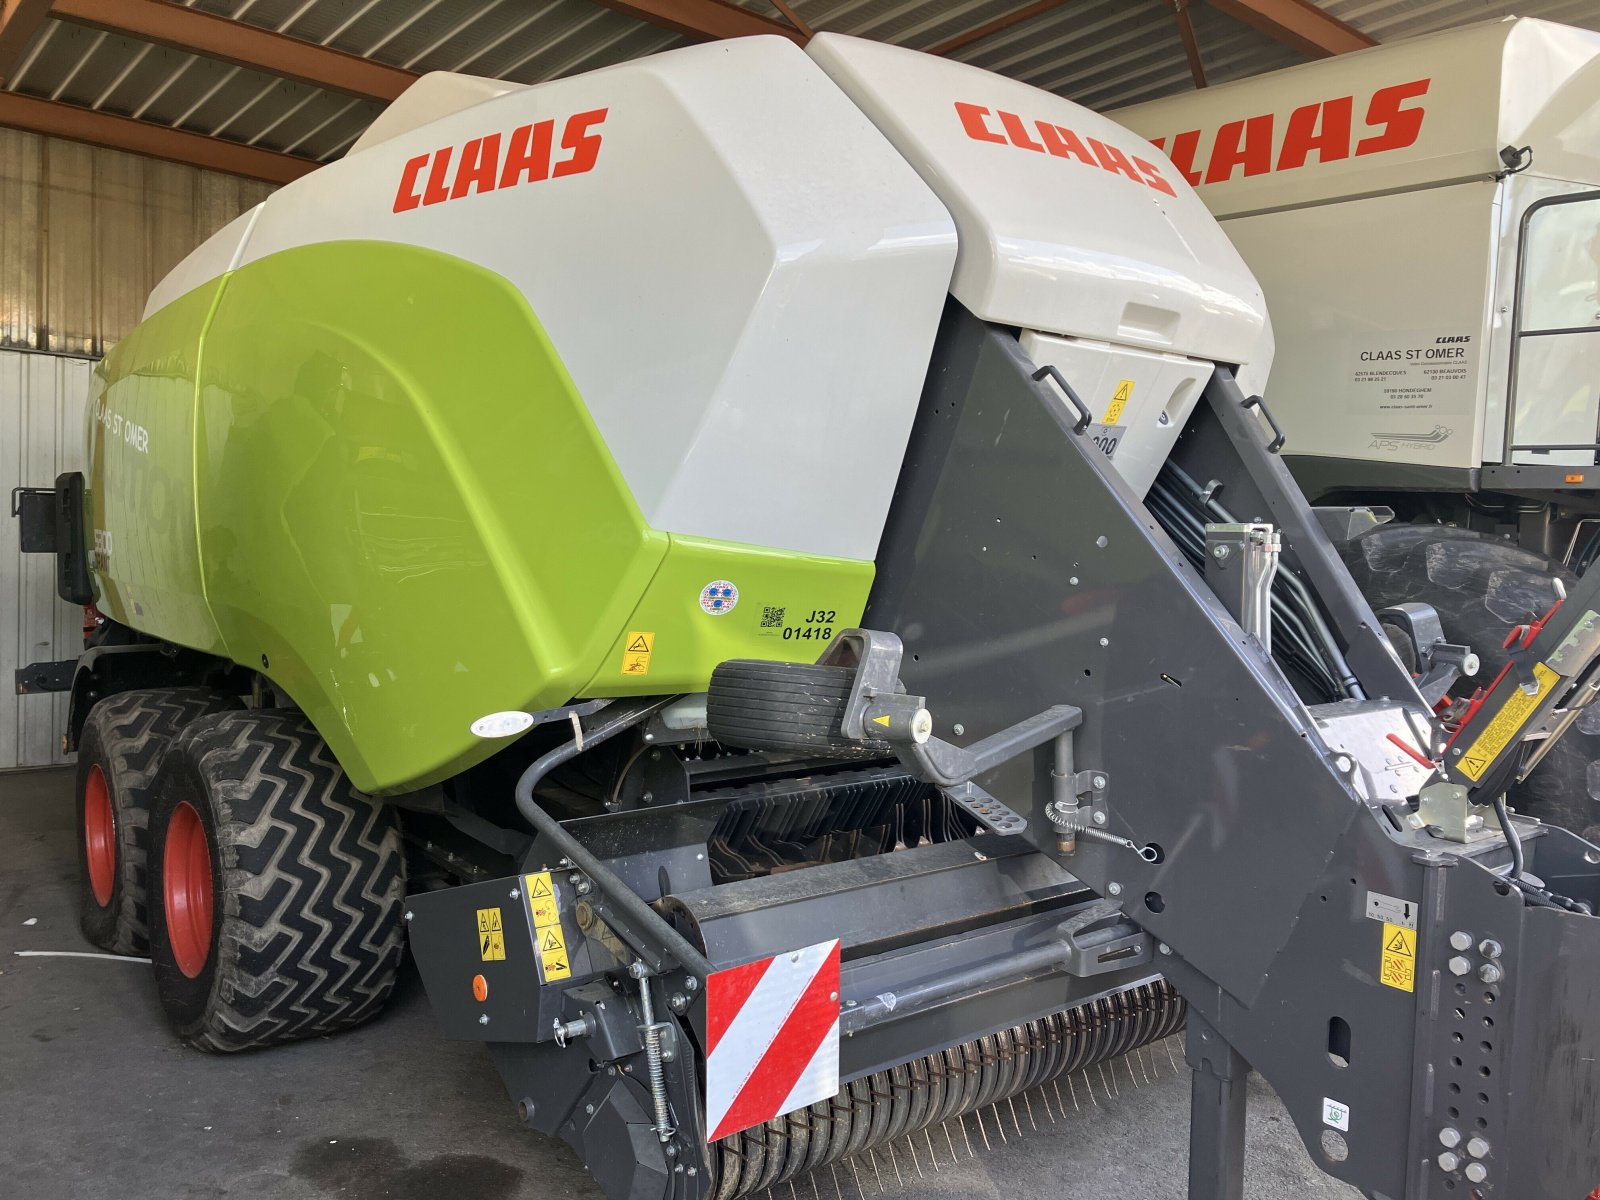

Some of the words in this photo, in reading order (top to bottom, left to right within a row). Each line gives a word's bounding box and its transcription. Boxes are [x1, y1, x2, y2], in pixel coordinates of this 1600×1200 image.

[953, 101, 1178, 198] CLAAS
[392, 107, 609, 214] CLAAS
[1435, 335, 1472, 344] CLAAS
[1360, 350, 1402, 361] CLAAS
[1405, 349, 1422, 360] ST
[1425, 347, 1465, 359] OMER
[112, 413, 123, 437] ST
[124, 419, 149, 455] OMER
[1367, 439, 1401, 452] APS
[805, 610, 836, 624] J32
[782, 627, 833, 640] 01418
